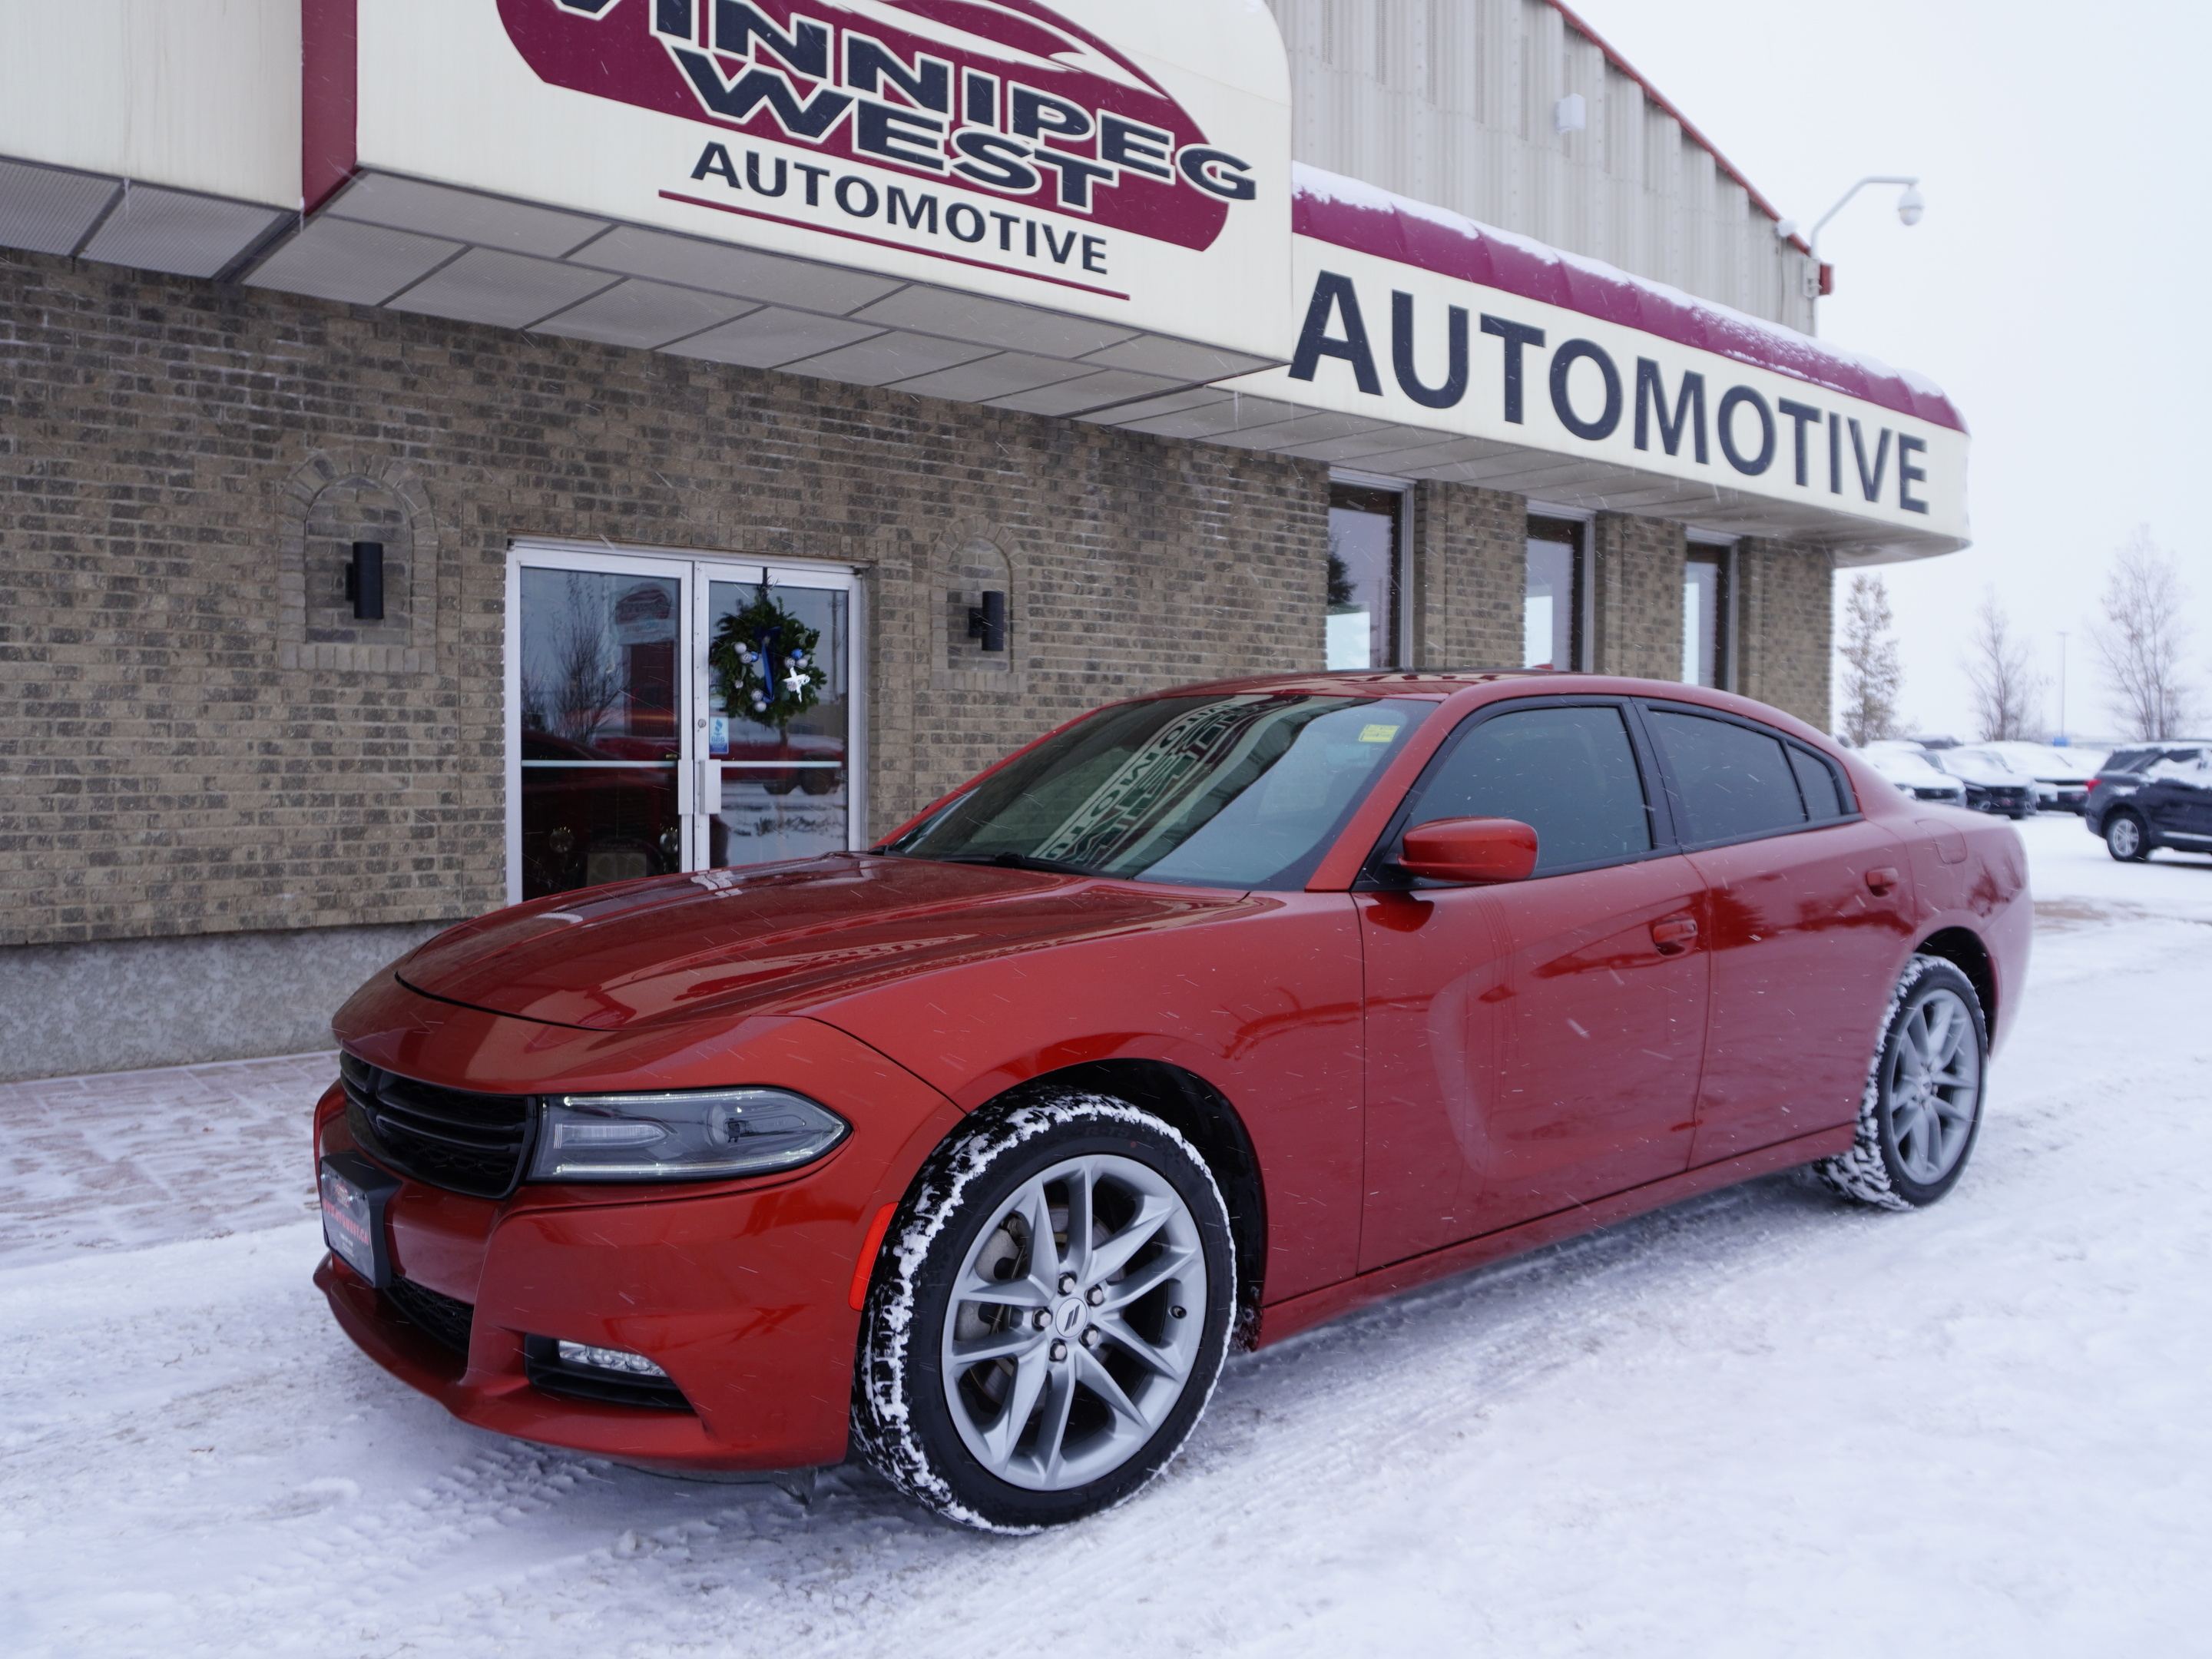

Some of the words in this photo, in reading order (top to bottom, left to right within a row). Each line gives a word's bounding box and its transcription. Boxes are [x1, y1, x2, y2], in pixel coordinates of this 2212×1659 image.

[559, 0, 1257, 201] INNIPEG
[670, 45, 1114, 210] WEST
[689, 141, 1109, 276] AUTOMOTIVE
[1287, 269, 1931, 515] AUTOMOTIVE
